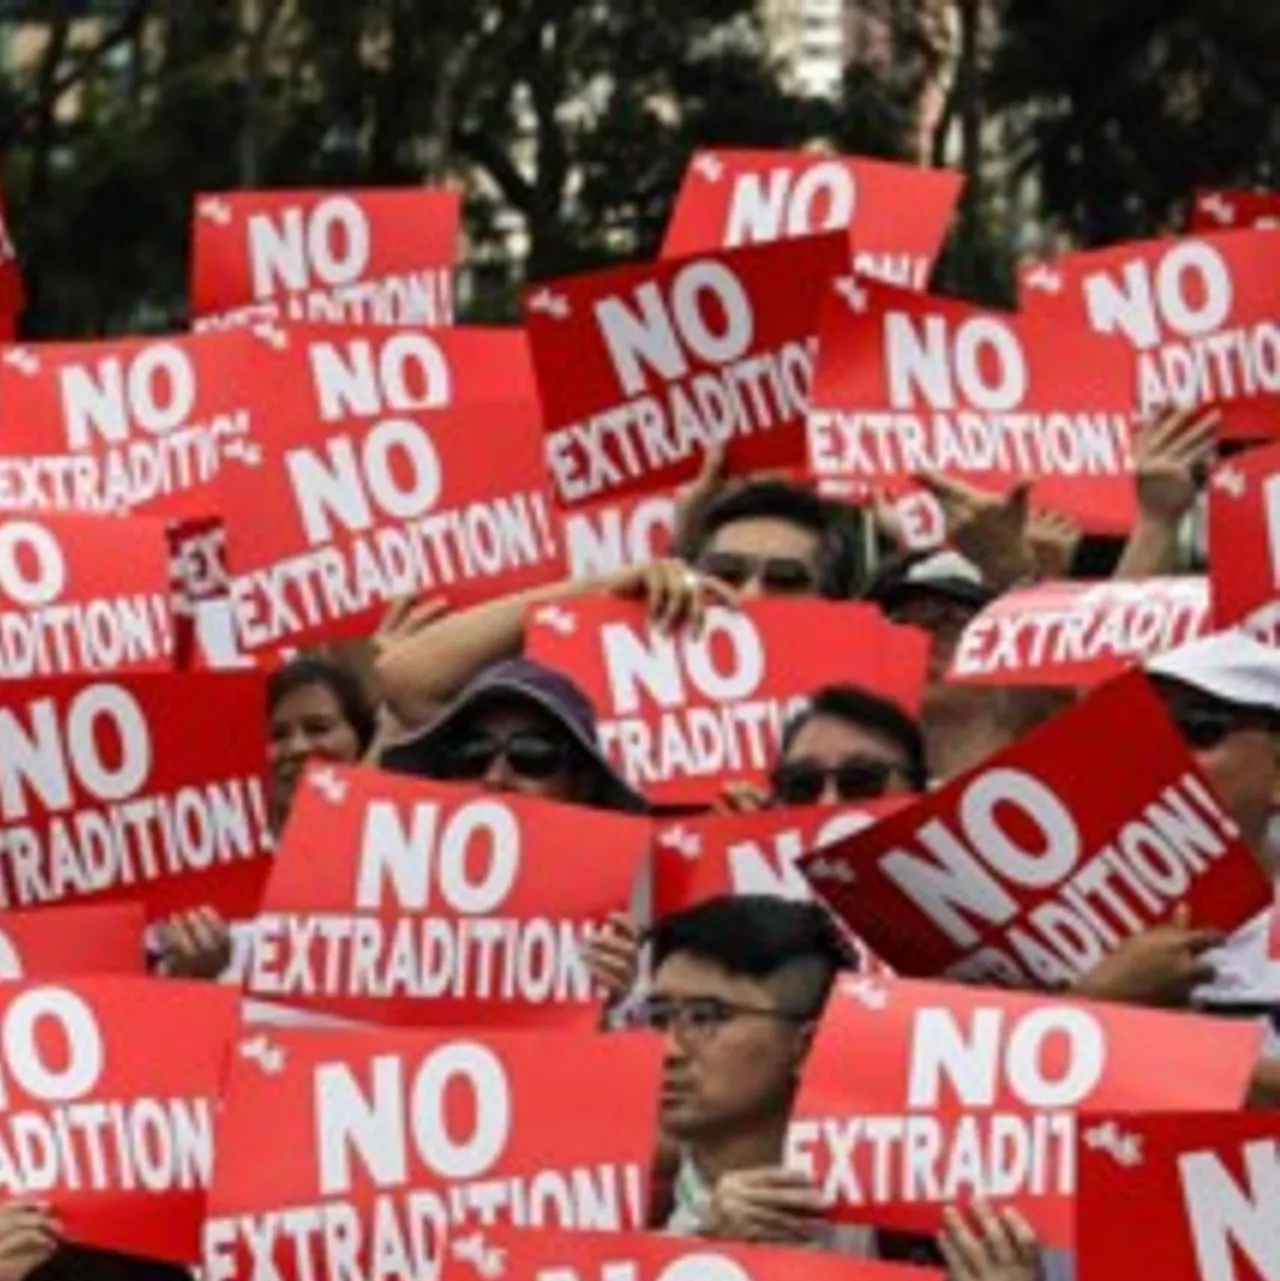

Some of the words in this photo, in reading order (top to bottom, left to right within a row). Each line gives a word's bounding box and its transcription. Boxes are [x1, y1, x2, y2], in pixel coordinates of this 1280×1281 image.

[246, 196, 370, 302] NO
[1083, 239, 1232, 349] NO
[308, 333, 451, 421] NO
[595, 259, 756, 397] NO
[883, 310, 1028, 410] NO
[58, 342, 196, 450] NO
[545, 336, 820, 501] EXTRADITIO
[806, 409, 1135, 476] EXTRADITION!
[286, 419, 442, 544] NO
[229, 491, 556, 647] EXTRADITION!
[601, 605, 765, 715] NO
[354, 798, 522, 914] NO
[878, 767, 1080, 948] NO
[907, 1005, 1108, 1110] NO
[313, 1040, 512, 1196] NO
[783, 1110, 1076, 1206] EXTRADIT
